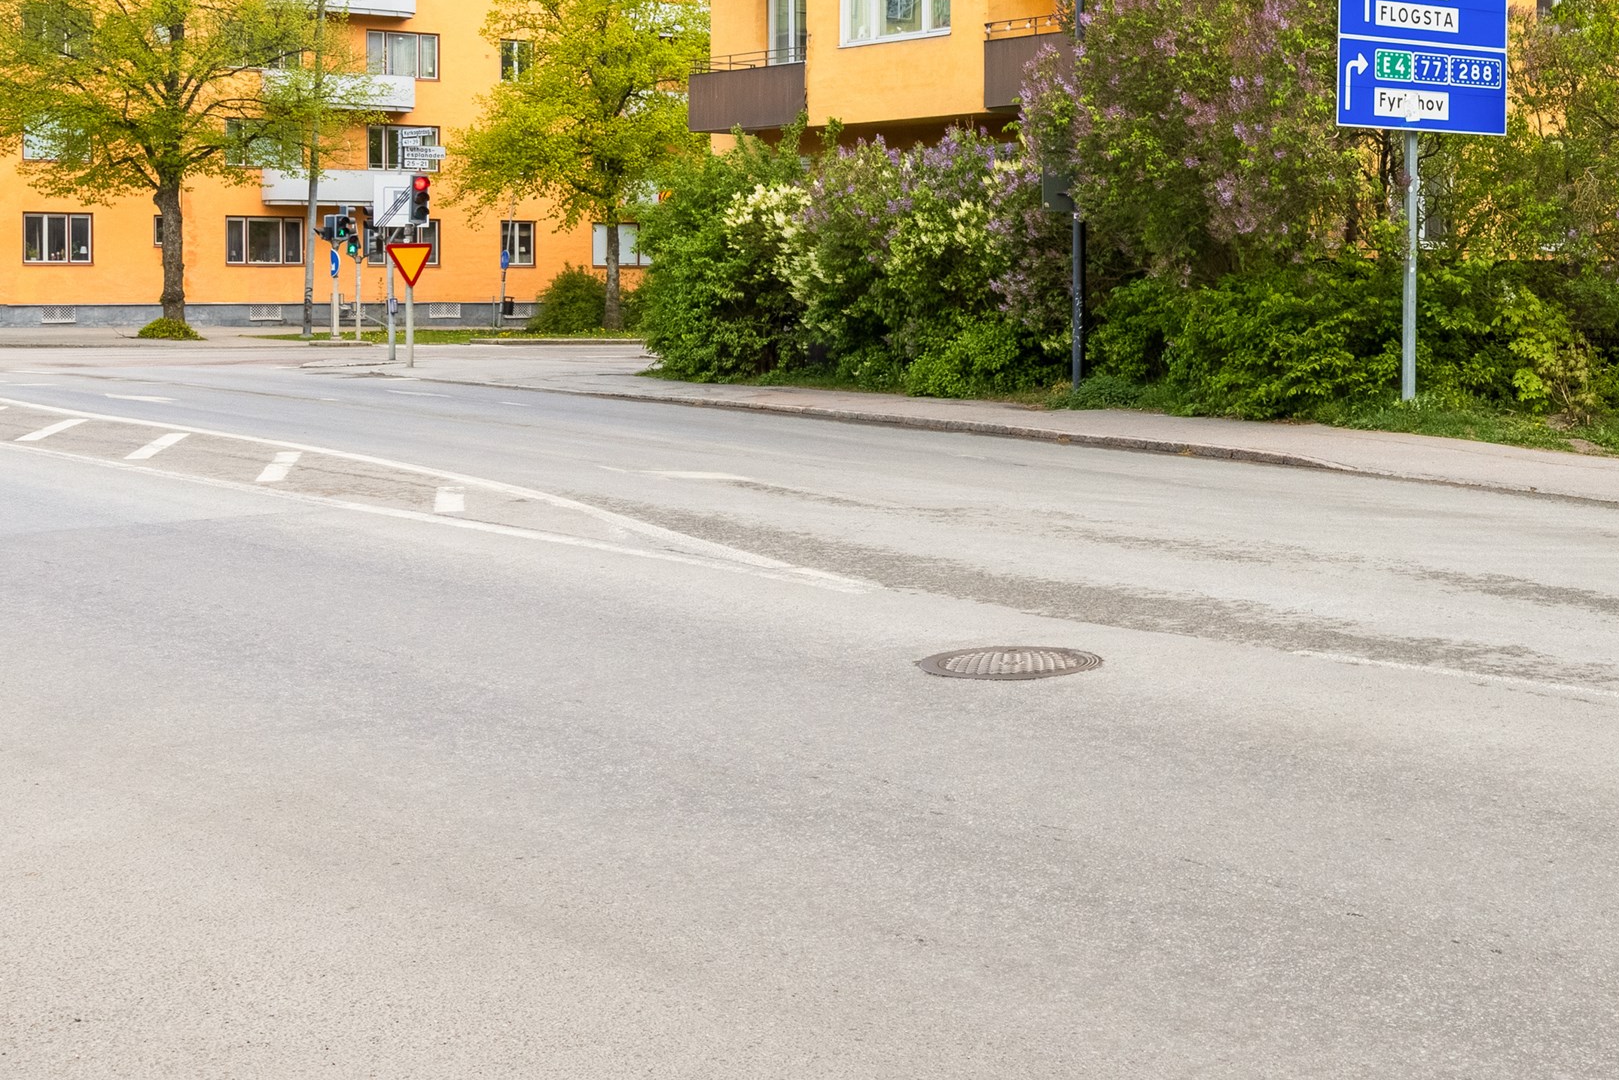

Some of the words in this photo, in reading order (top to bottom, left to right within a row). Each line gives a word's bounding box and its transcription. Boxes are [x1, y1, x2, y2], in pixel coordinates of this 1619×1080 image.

[1380, 5, 1454, 28] FLOGSTA
[1420, 60, 1442, 78] 77
[1458, 63, 1492, 81] 288
[1379, 91, 1444, 112] Fyrhov
